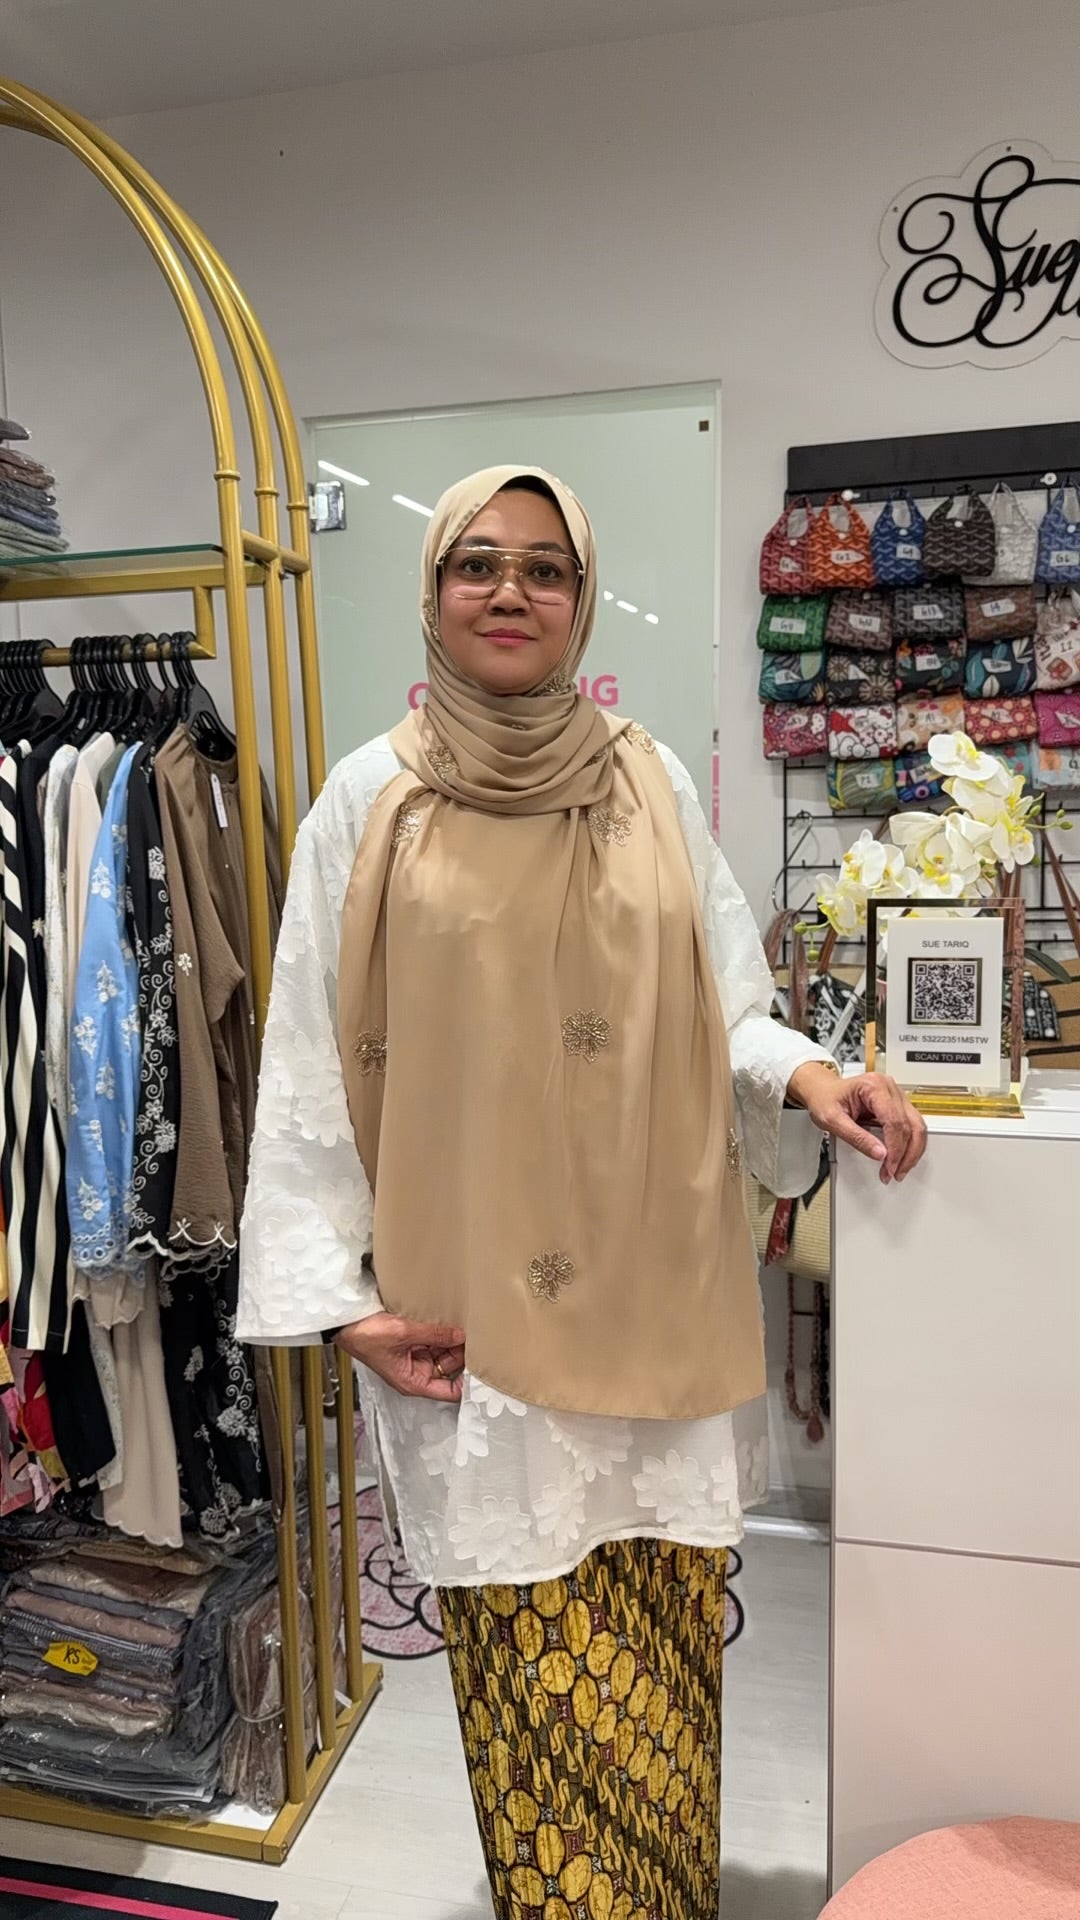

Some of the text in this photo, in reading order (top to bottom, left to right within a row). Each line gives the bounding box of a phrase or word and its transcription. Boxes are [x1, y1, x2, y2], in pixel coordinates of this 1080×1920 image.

[922, 940, 969, 949] SUE TARIQ
[899, 1034, 989, 1045] UEN: 53222351MSTW
[914, 1053, 973, 1063] SCAN TO PAY
